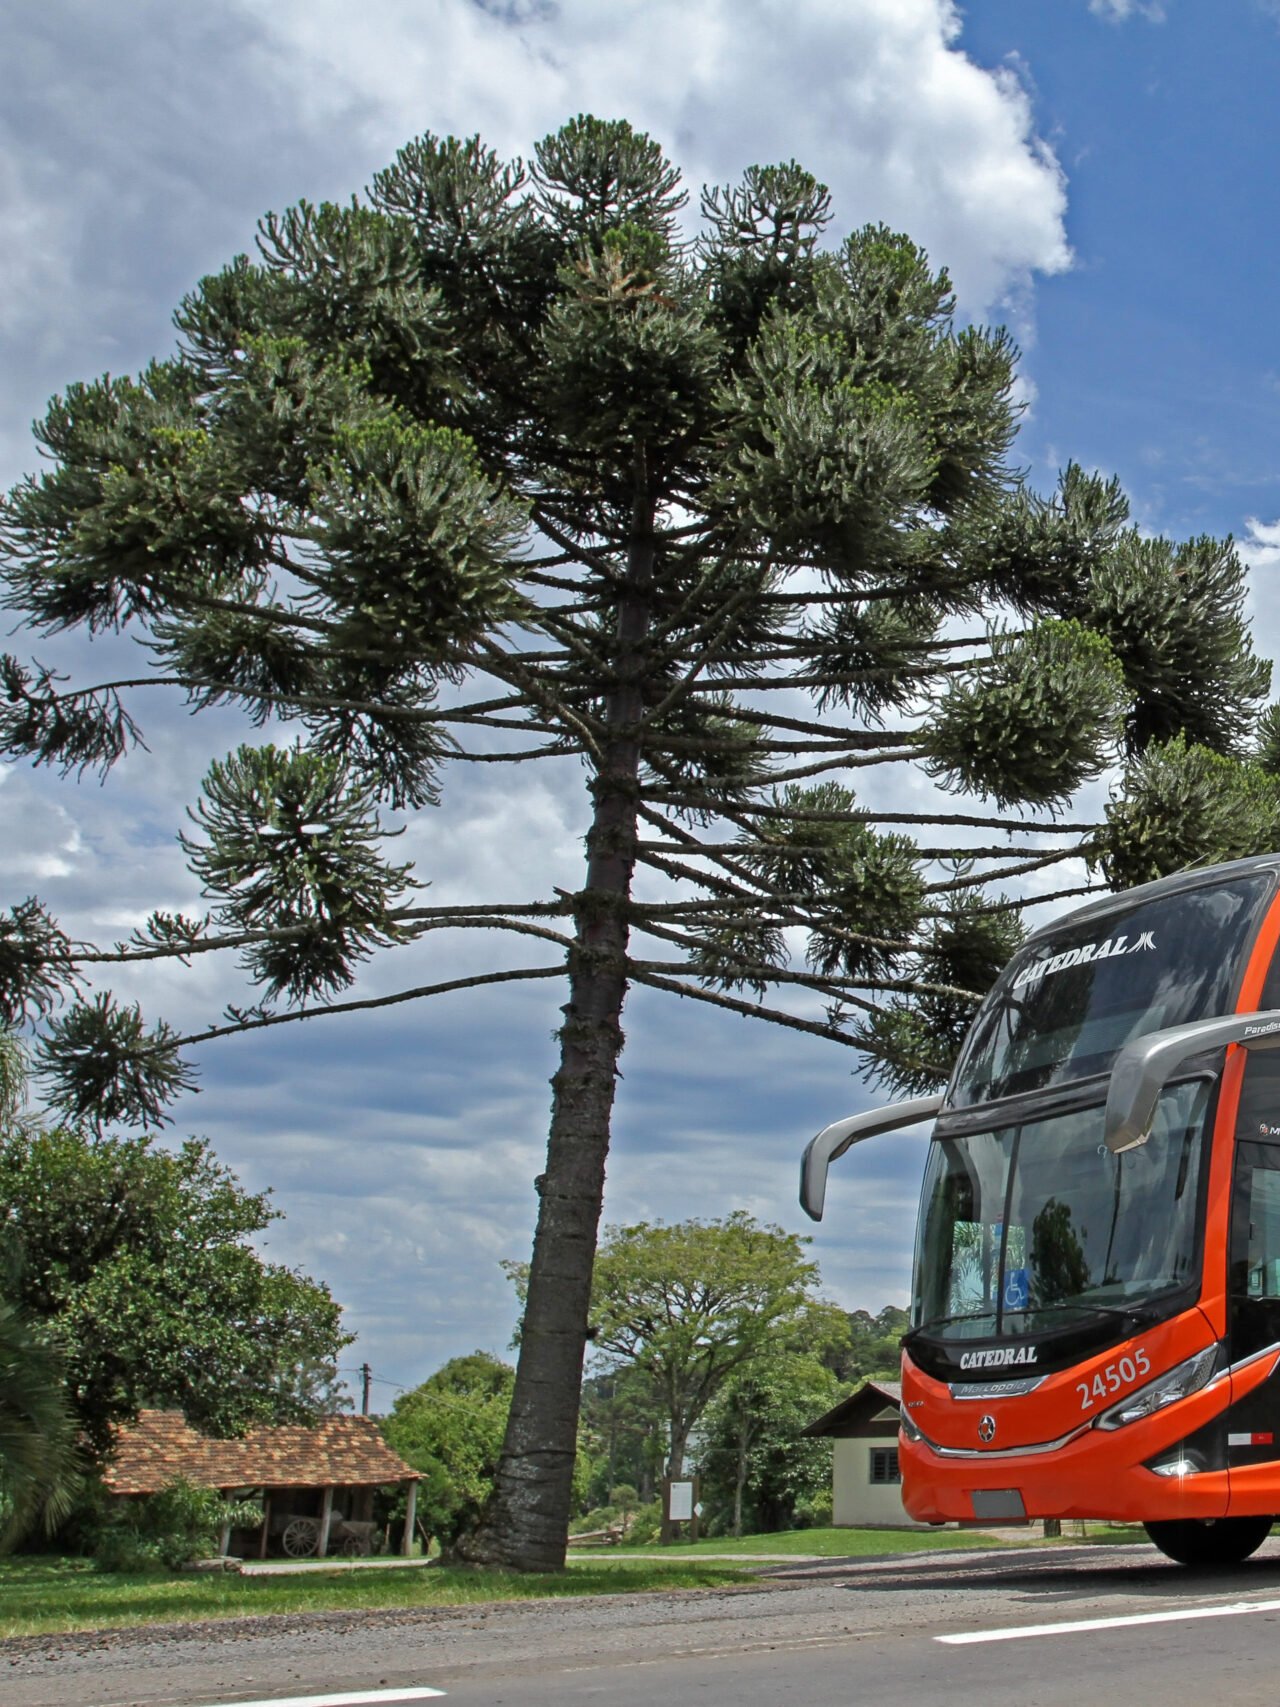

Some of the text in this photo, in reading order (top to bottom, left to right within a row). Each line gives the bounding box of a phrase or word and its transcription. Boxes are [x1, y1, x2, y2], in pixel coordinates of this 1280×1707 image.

[1013, 936, 1128, 990] CATEDRAL
[960, 1346, 1038, 1370] CATEDRAL
[960, 1381, 1027, 1394] Marcopolo
[1076, 1348, 1151, 1410] 24505
